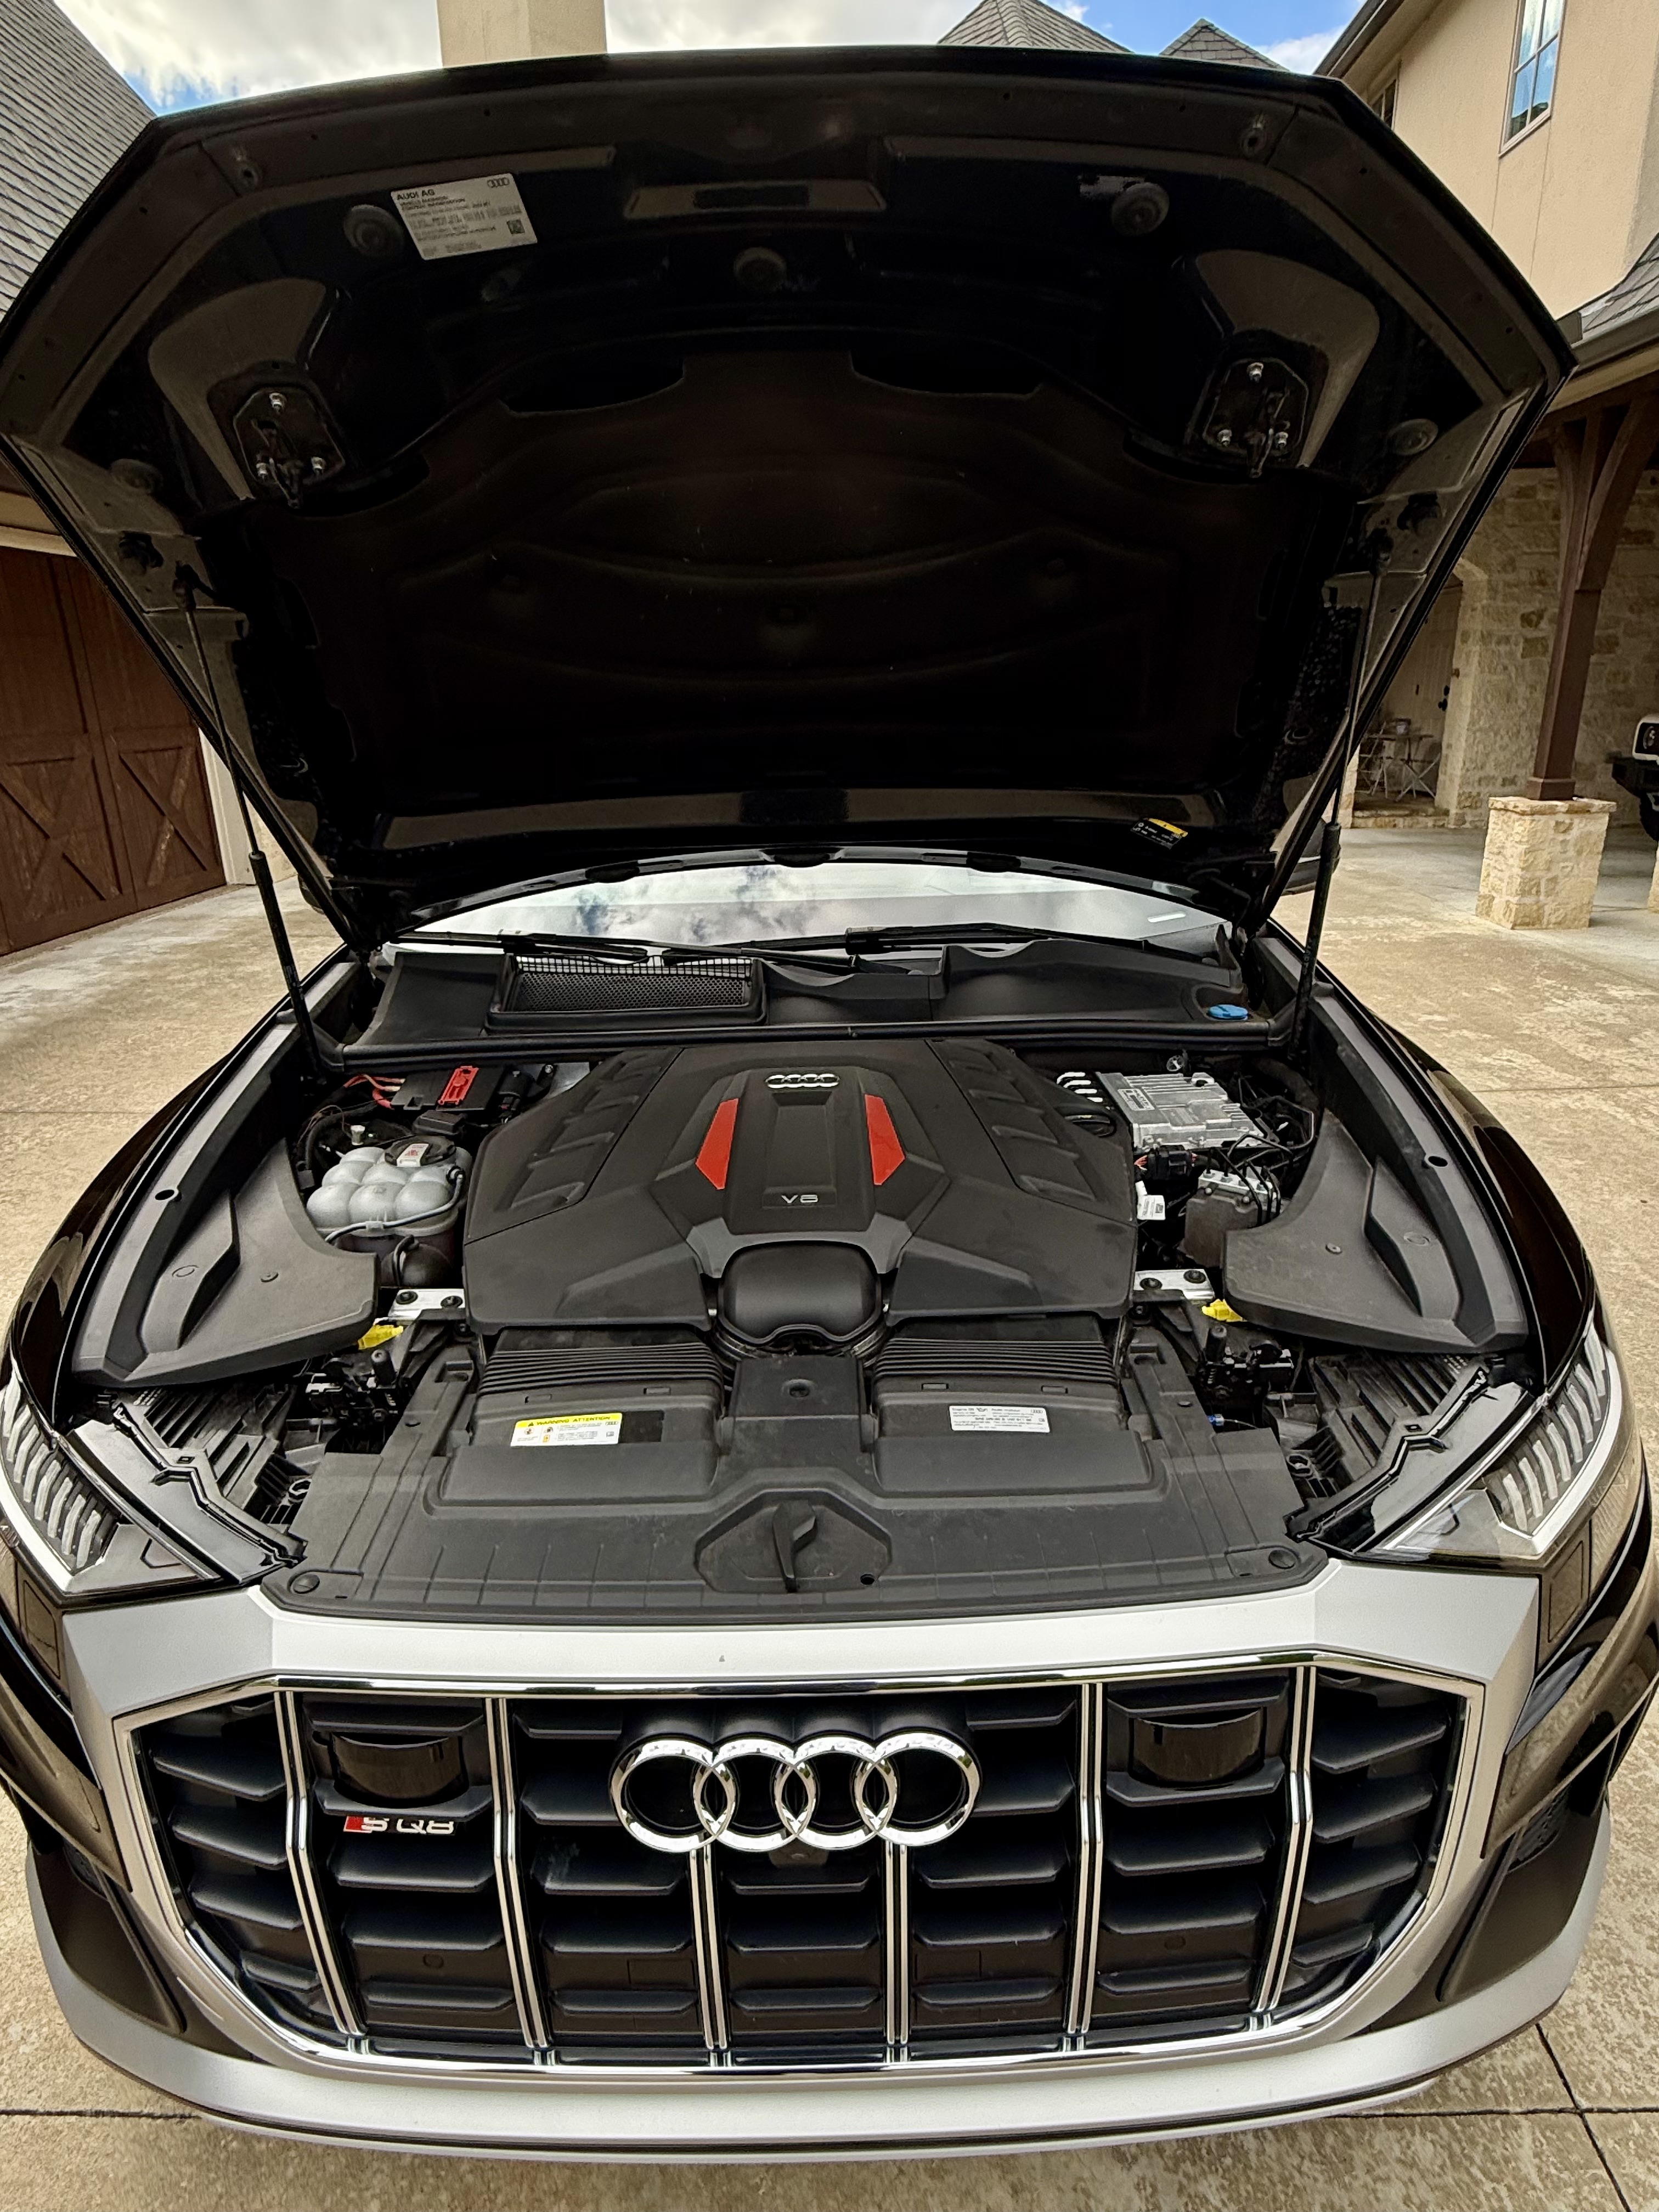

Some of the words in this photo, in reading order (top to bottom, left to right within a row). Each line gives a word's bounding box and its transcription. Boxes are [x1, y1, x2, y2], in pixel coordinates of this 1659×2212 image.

[397, 190, 419, 201] AUDI
[421, 189, 436, 198] AG
[781, 1194, 819, 1204] V8
